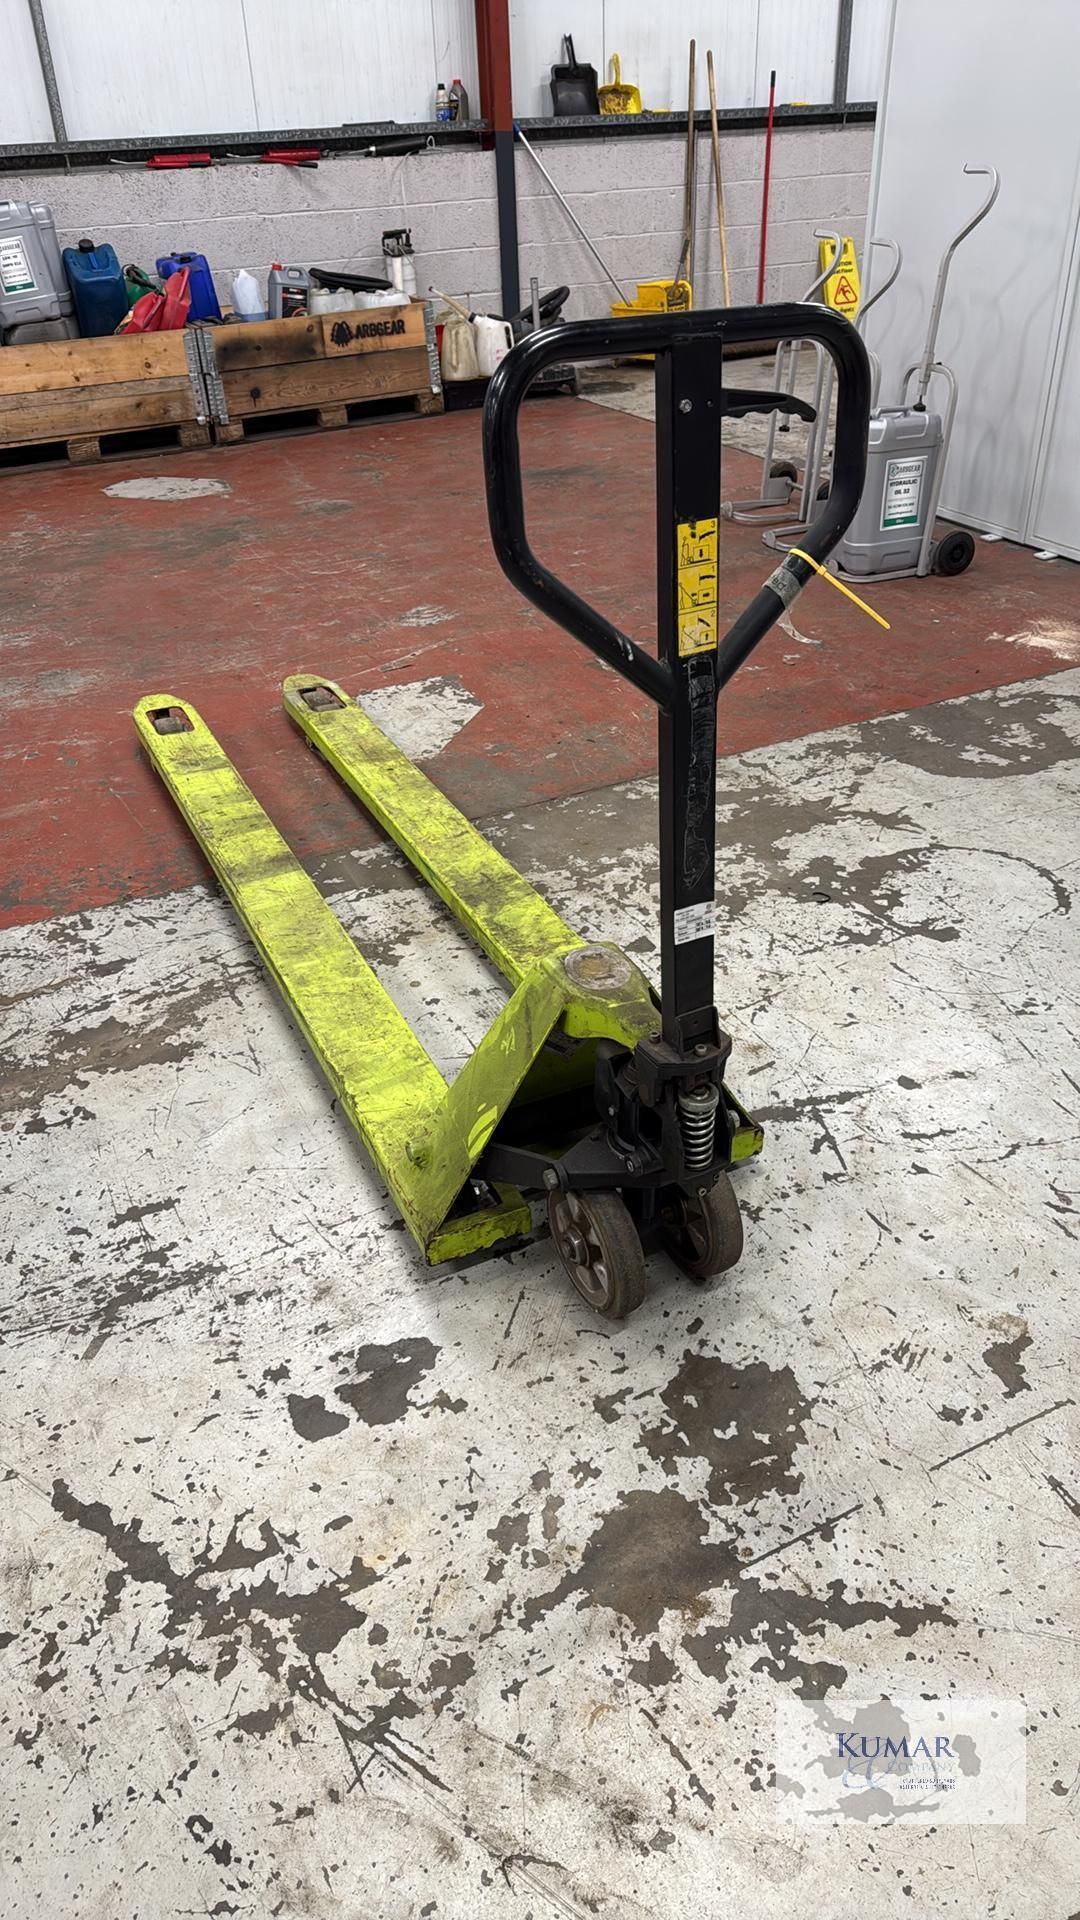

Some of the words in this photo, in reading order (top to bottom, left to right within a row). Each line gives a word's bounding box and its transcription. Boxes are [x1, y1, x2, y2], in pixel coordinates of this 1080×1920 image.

[355, 319, 406, 339] ARBGEAR
[889, 479, 918, 488] HYDRAULIC
[710, 520, 716, 529] 3
[710, 609, 716, 618] 2
